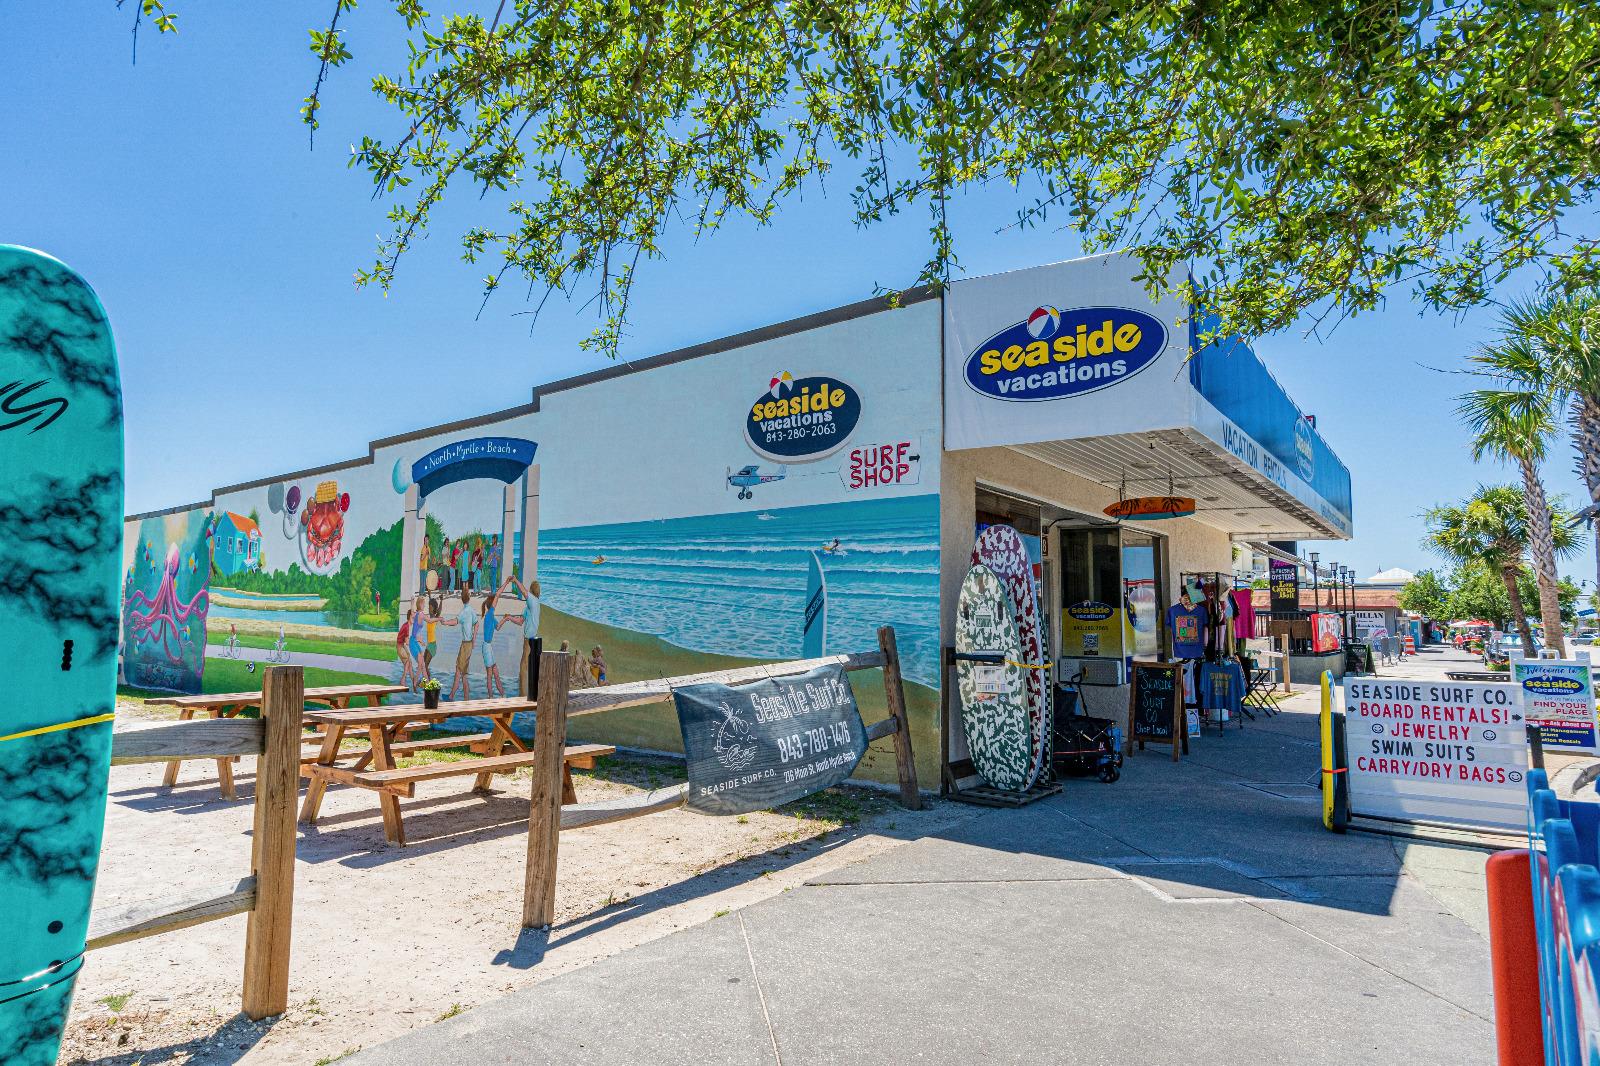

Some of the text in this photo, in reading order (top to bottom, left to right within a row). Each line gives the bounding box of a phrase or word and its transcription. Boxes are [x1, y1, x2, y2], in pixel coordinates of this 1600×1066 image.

[980, 320, 1142, 375] seaside
[997, 359, 1127, 394] vacations
[752, 383, 846, 422] seaside
[759, 410, 833, 433] vacations
[766, 423, 836, 443] 843-280-2063
[429, 441, 511, 469] North Myrtle Beach
[850, 442, 911, 470] SURF
[1222, 421, 1259, 469] VACATION
[1263, 453, 1287, 490] RENTALS
[850, 464, 910, 489] SHOP
[1071, 605, 1111, 614] seaside
[1526, 665, 1565, 675] Welcome
[1351, 684, 1513, 706] SEASIDE SURF CO.
[1526, 680, 1580, 689] seaside
[750, 685, 810, 724] Seaside
[806, 678, 835, 711] Surf
[1556, 708, 1588, 716] PLACE
[1560, 702, 1587, 710] YOUR
[1360, 702, 1509, 725] BOARD RENTALS!
[777, 720, 851, 763] 843-780-1476
[1391, 722, 1471, 741] JEWELRY
[1372, 739, 1475, 761] SWIM SUITS
[794, 765, 809, 780] Main
[1357, 756, 1506, 784] CARRY/DRY BAGS
[701, 769, 777, 796] SEASIDE SURF CO.
